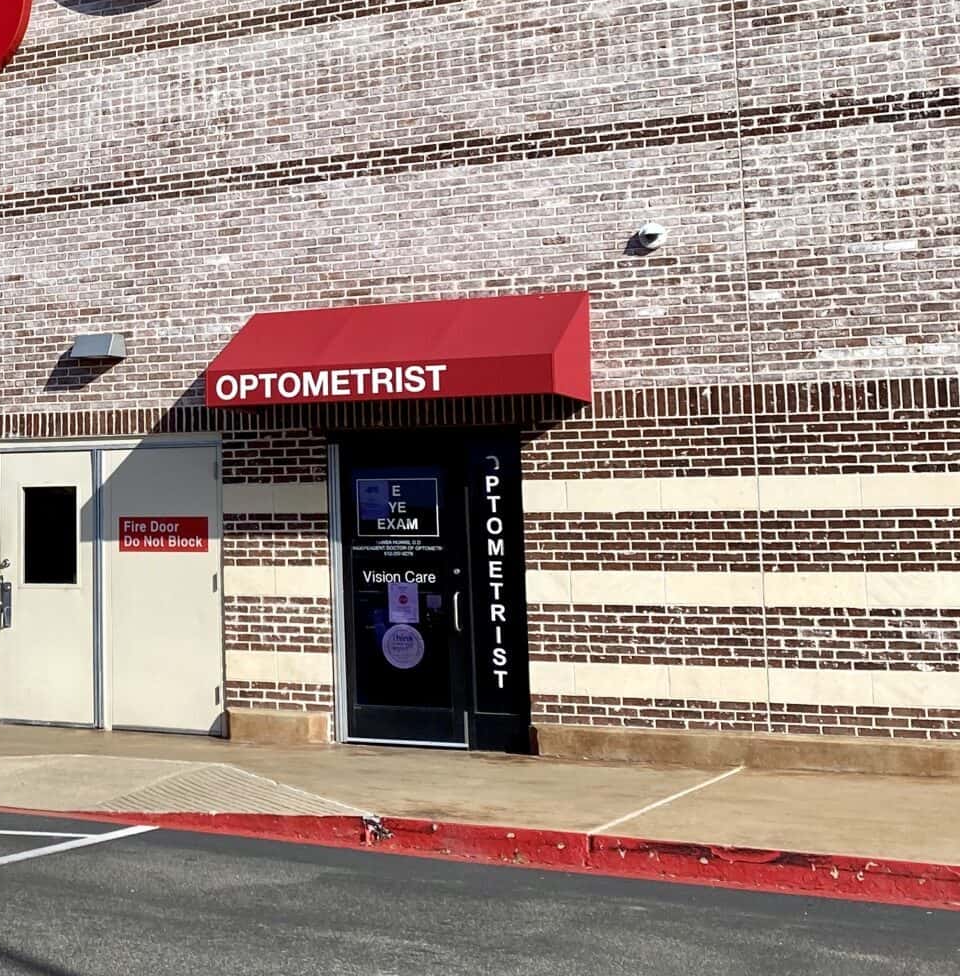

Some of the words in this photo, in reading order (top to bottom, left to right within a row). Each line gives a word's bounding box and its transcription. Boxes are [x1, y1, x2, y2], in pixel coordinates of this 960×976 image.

[215, 364, 447, 401] OPTOMETRIST
[392, 485, 401, 497] E
[388, 501, 407, 513] YE
[124, 520, 147, 533] Fire
[150, 520, 180, 533] Door
[377, 518, 419, 530] EXAM
[124, 535, 140, 548] Do
[143, 535, 164, 548] Not
[168, 535, 203, 548] Block
[362, 570, 401, 584] Vision
[404, 570, 437, 584] Care
